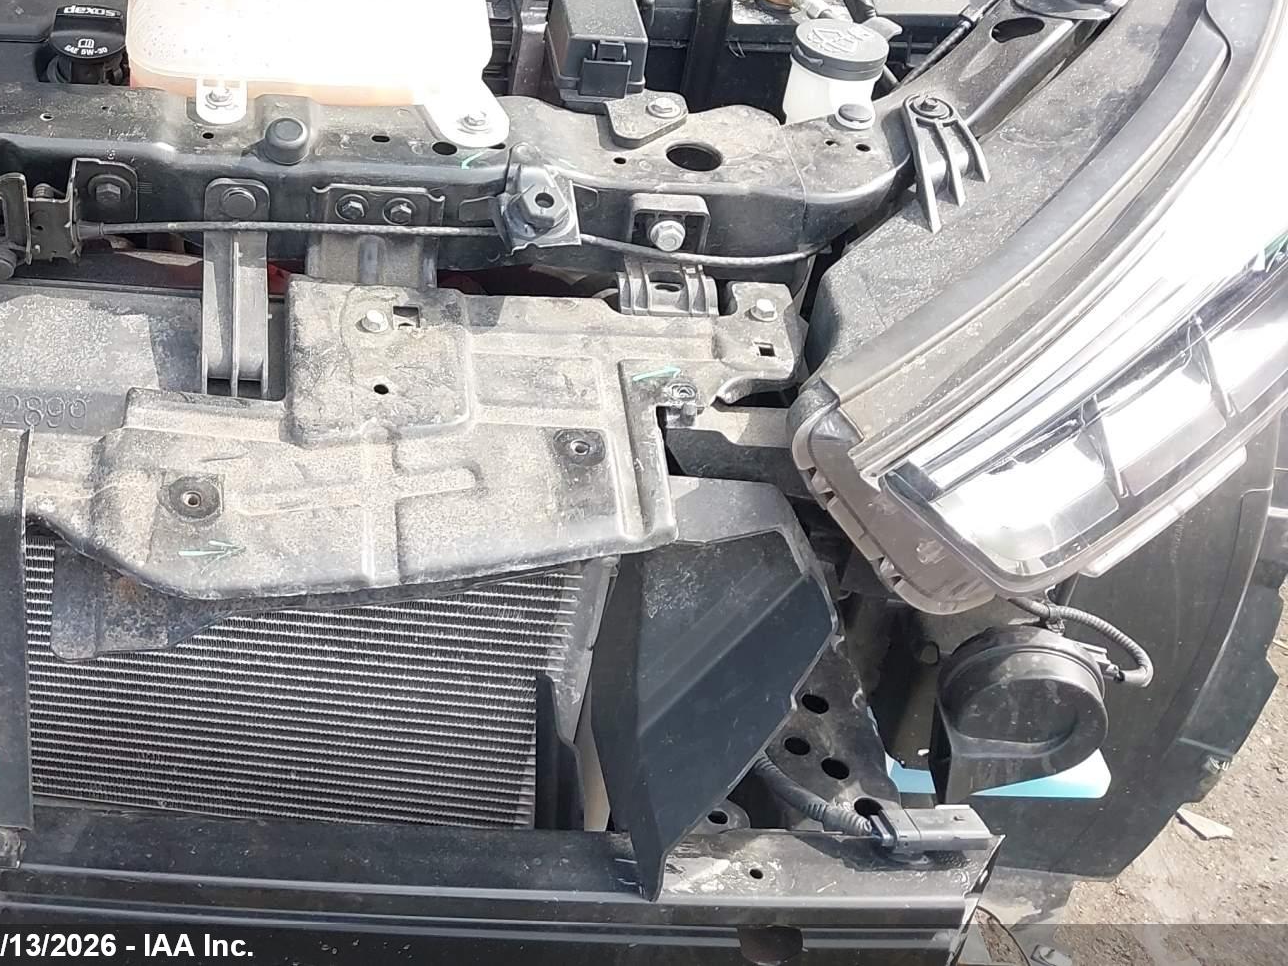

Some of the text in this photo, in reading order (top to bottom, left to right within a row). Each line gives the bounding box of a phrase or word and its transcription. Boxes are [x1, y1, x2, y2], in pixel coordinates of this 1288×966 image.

[63, 5, 116, 17] dexos
[64, 44, 109, 56] SAE 5W-30
